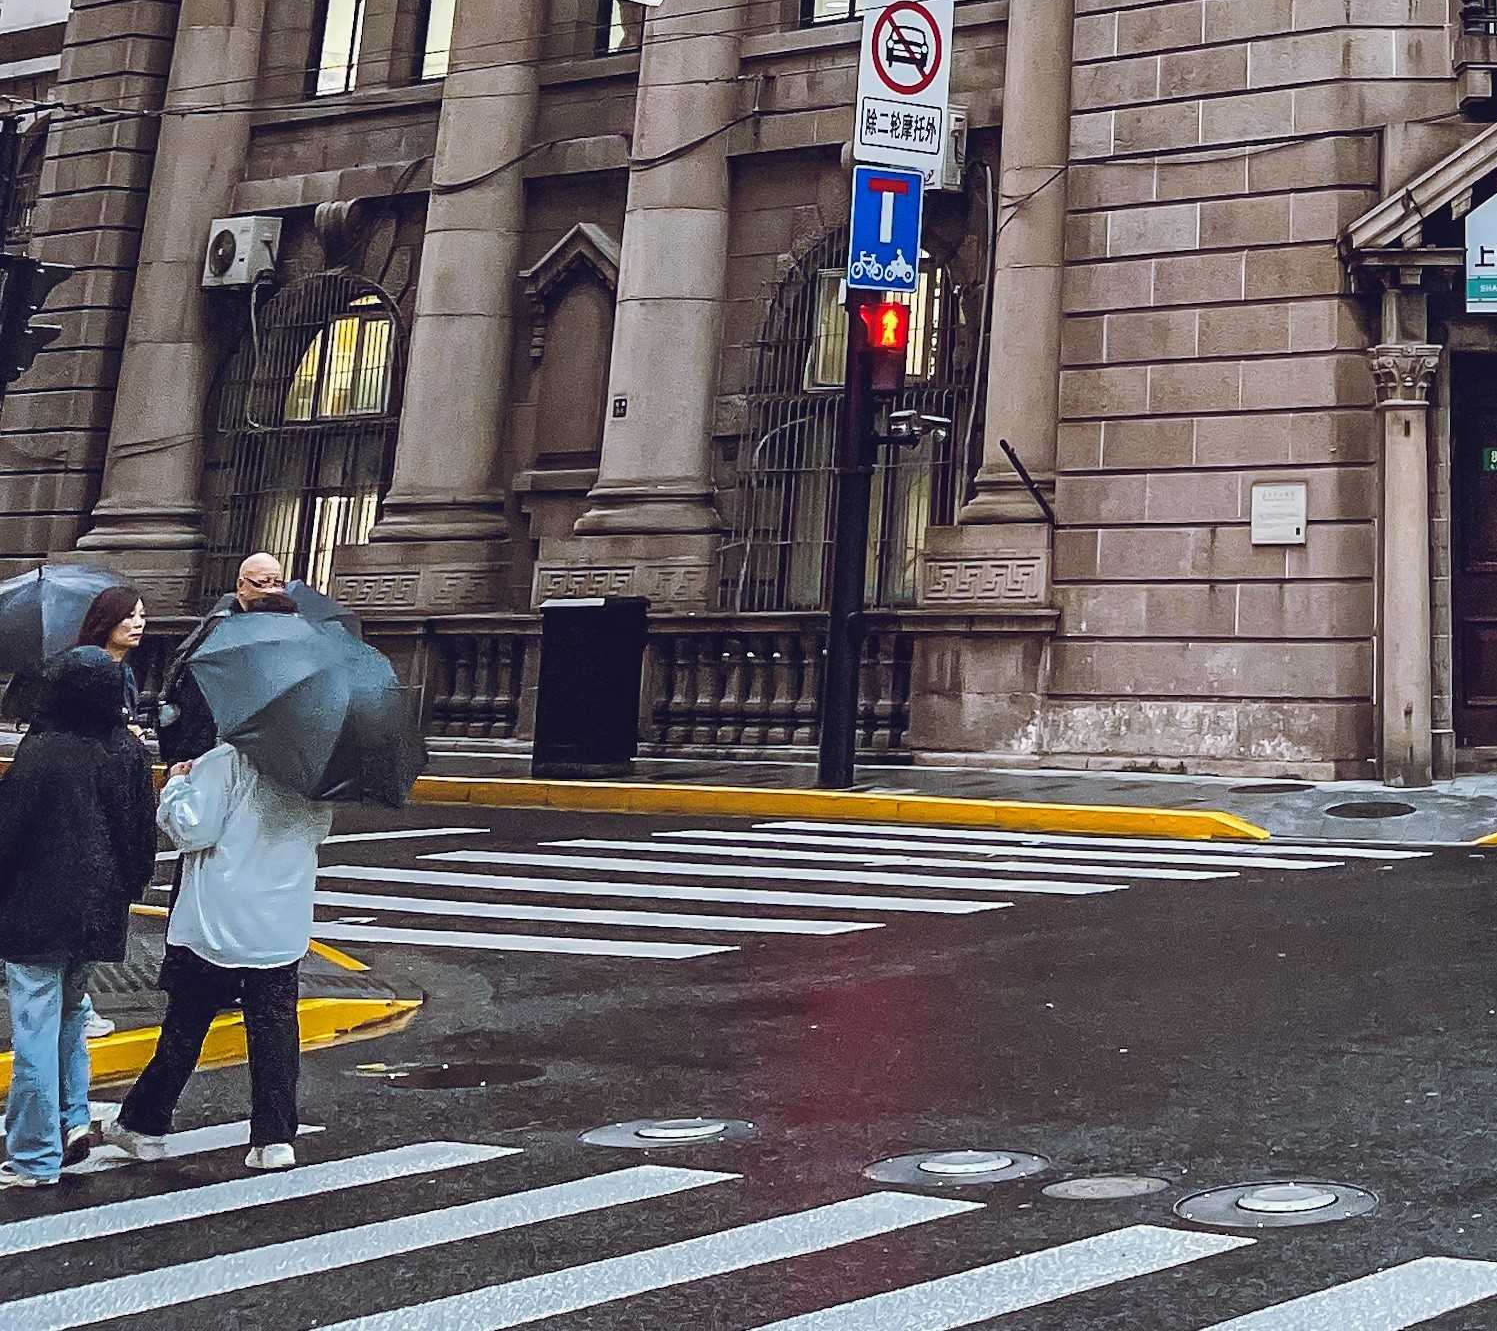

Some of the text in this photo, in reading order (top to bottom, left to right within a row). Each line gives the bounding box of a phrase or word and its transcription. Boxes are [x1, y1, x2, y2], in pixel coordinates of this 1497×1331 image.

[865, 108, 937, 145] 除二轮摩托外
